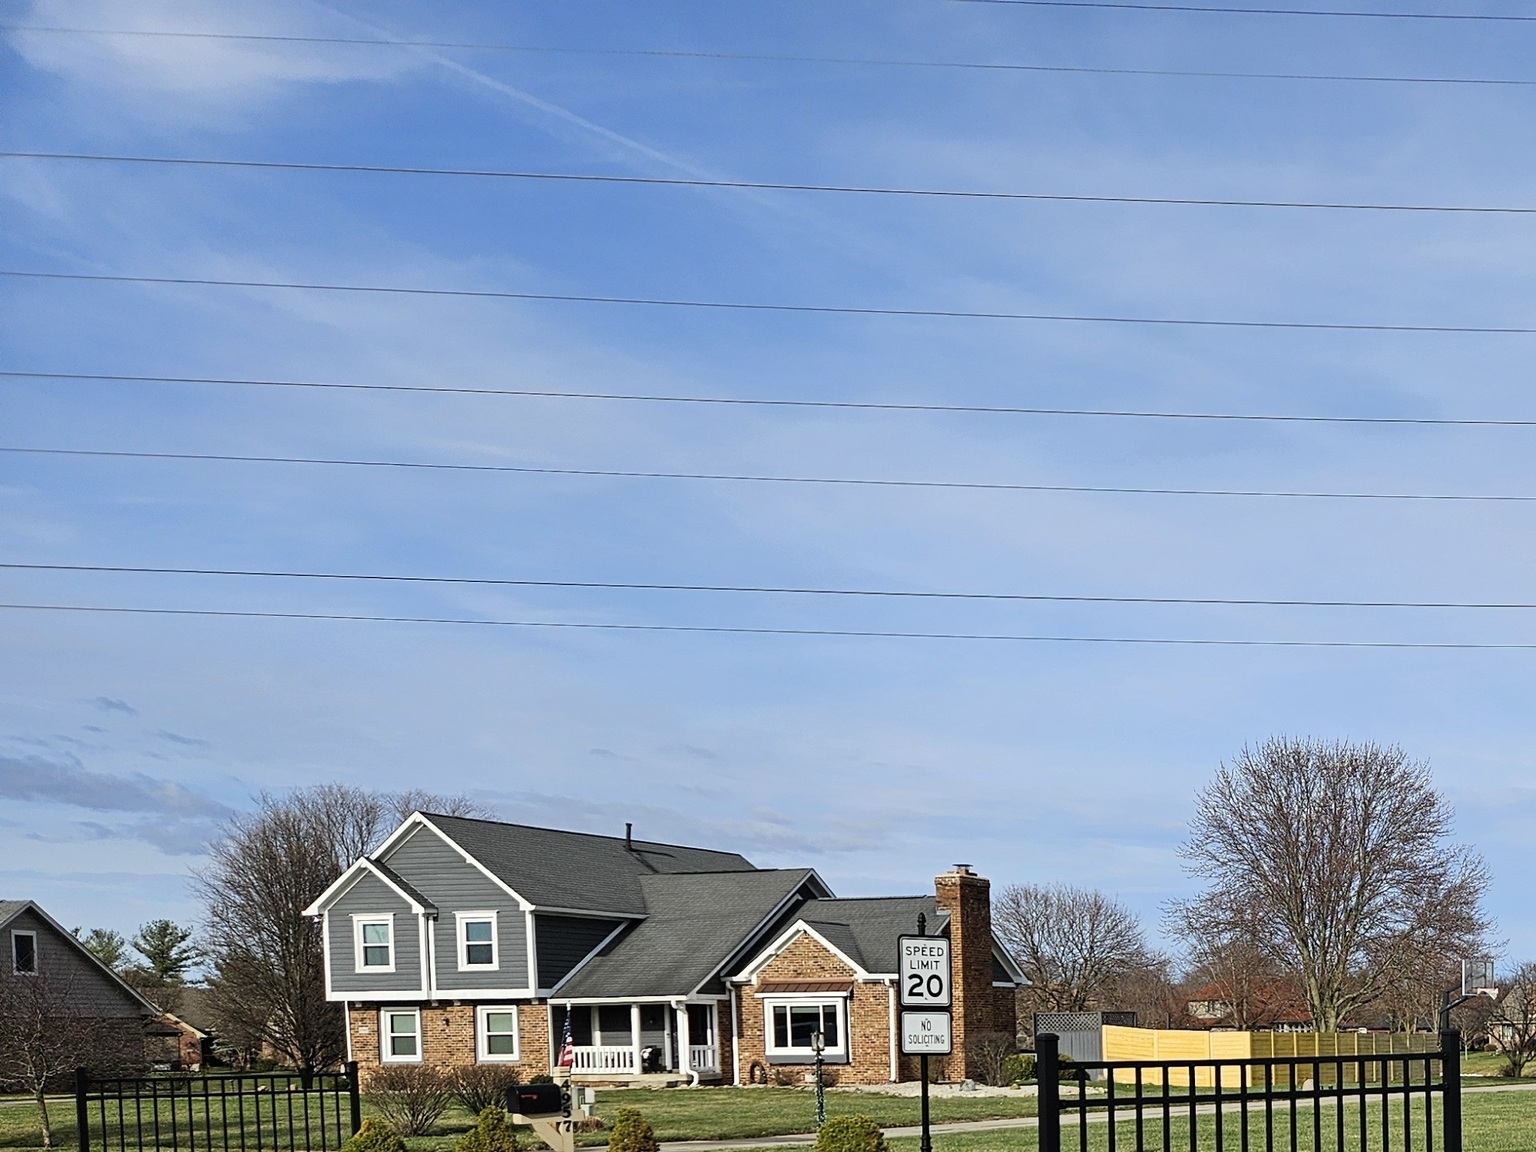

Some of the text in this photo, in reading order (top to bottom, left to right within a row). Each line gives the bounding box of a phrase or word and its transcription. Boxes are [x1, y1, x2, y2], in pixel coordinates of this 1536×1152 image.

[905, 946, 944, 957] SPEED
[910, 960, 940, 970] LIMIT
[907, 973, 943, 997] 20
[921, 1020, 932, 1031] NO
[908, 1034, 945, 1044] SOLICITING
[561, 1079, 572, 1133] 4957
